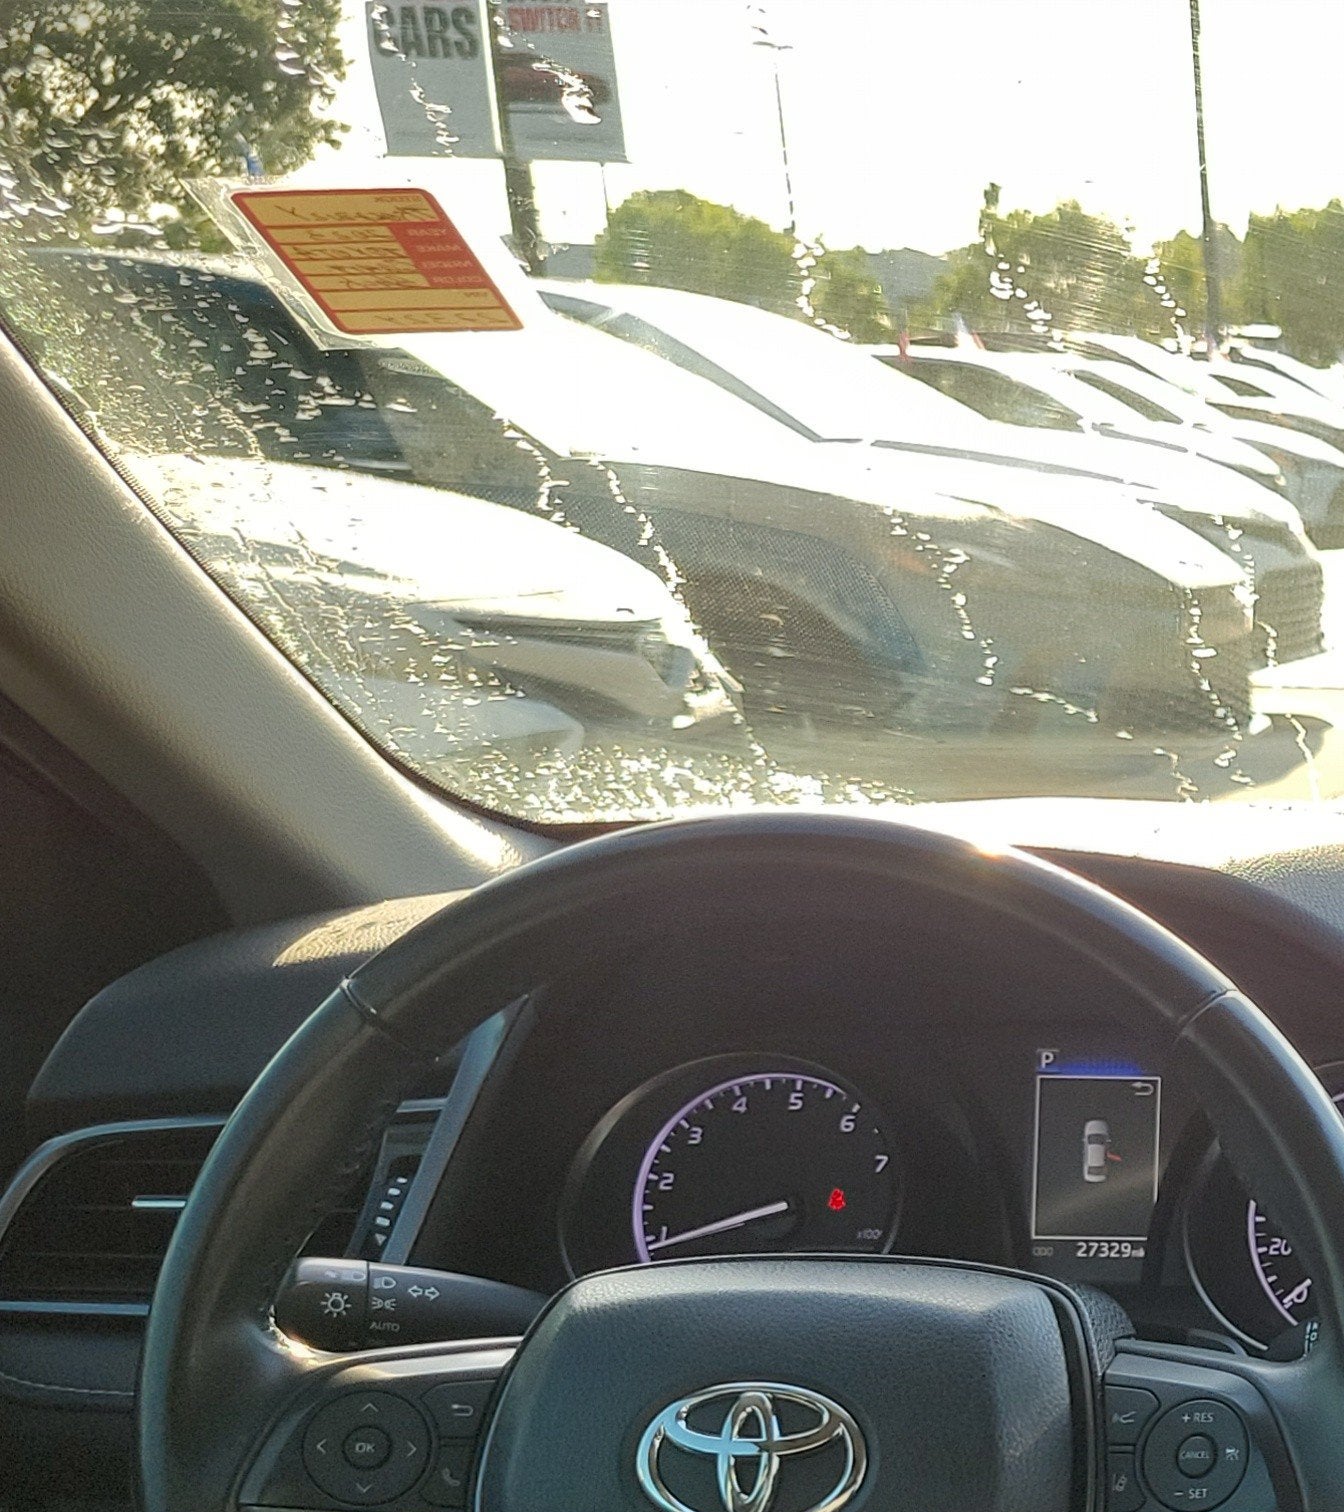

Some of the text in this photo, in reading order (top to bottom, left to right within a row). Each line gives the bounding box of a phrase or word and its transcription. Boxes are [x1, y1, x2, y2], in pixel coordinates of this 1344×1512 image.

[372, 5, 478, 60] CARS
[1041, 1052, 1054, 1069] P
[732, 1096, 748, 1114] 4
[788, 1092, 803, 1111] 5
[840, 1115, 856, 1133] 6
[688, 1127, 703, 1145] 3
[875, 1155, 889, 1173] 7
[659, 1173, 675, 1191] 2
[1076, 1242, 1132, 1258] 27329
[369, 1321, 400, 1332] AUTO
[1192, 1412, 1214, 1423] RES
[355, 1441, 375, 1453] OK
[1179, 1450, 1210, 1459] CANCEL
[1188, 1489, 1207, 1499] SET
